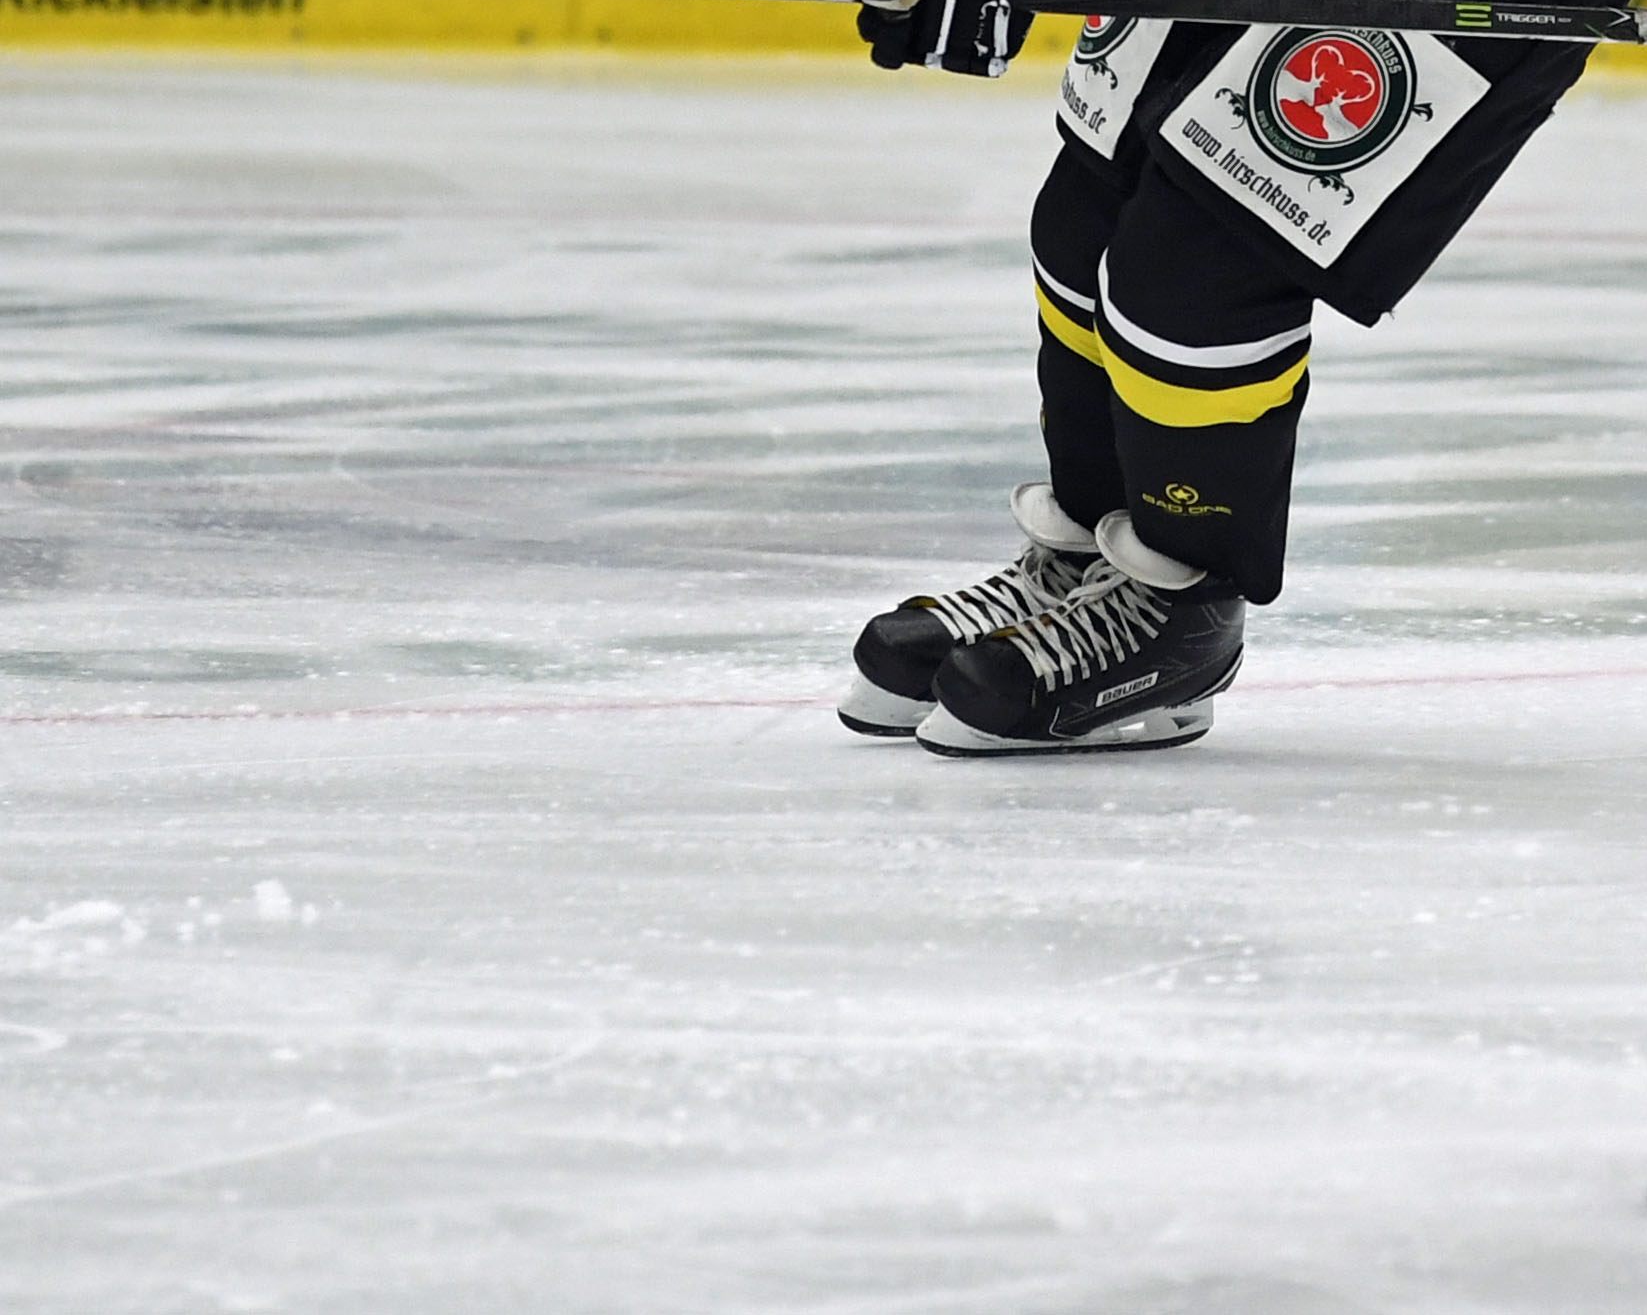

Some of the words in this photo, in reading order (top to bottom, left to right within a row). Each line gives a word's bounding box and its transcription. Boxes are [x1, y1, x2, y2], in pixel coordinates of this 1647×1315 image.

[1496, 11, 1556, 25] TRIGGER
[1181, 115, 1332, 247] www.hirschkuss.de
[1100, 674, 1155, 703] BAUER
